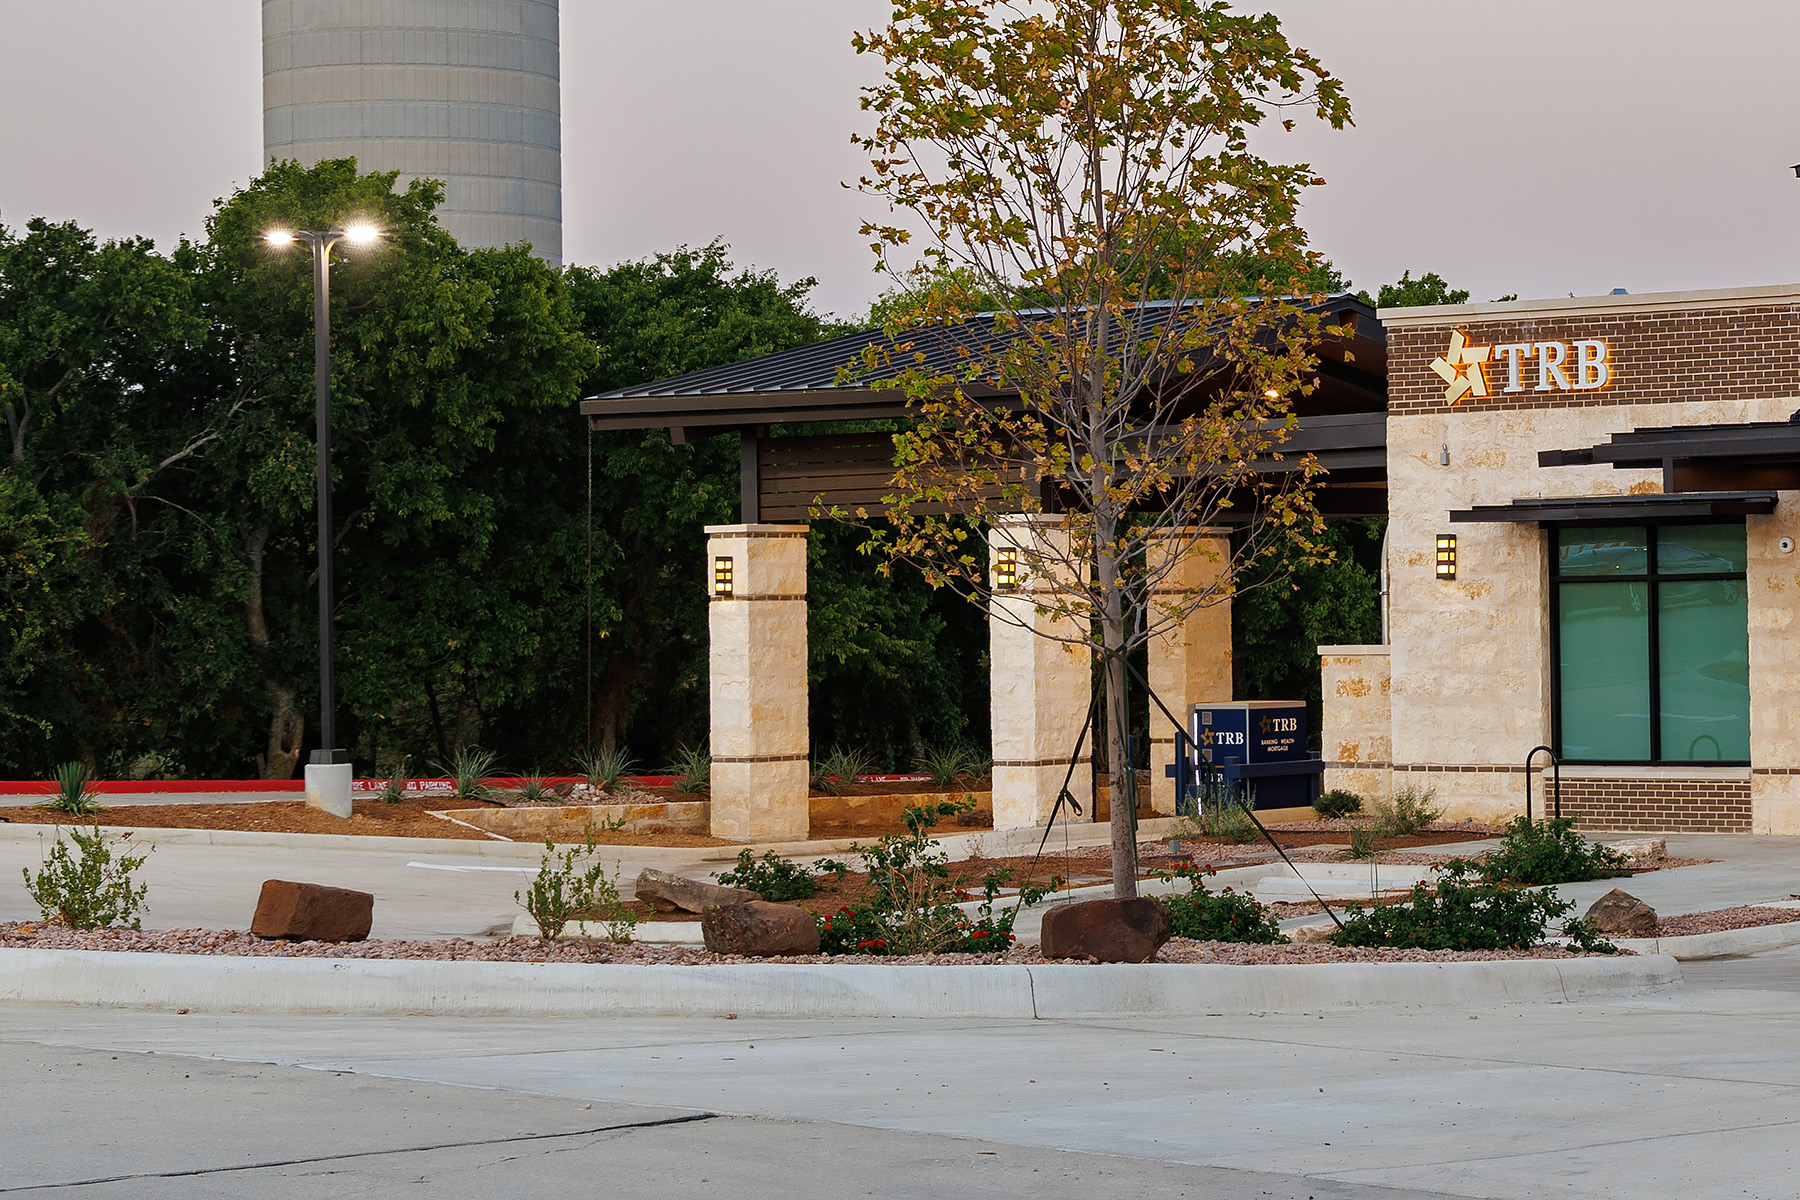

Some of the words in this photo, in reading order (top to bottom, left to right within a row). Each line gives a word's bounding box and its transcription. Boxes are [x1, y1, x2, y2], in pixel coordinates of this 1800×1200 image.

[1494, 340, 1608, 393] TRB
[1273, 718, 1297, 731] TRB
[1216, 732, 1244, 745] TRB
[406, 781, 417, 790] NO
